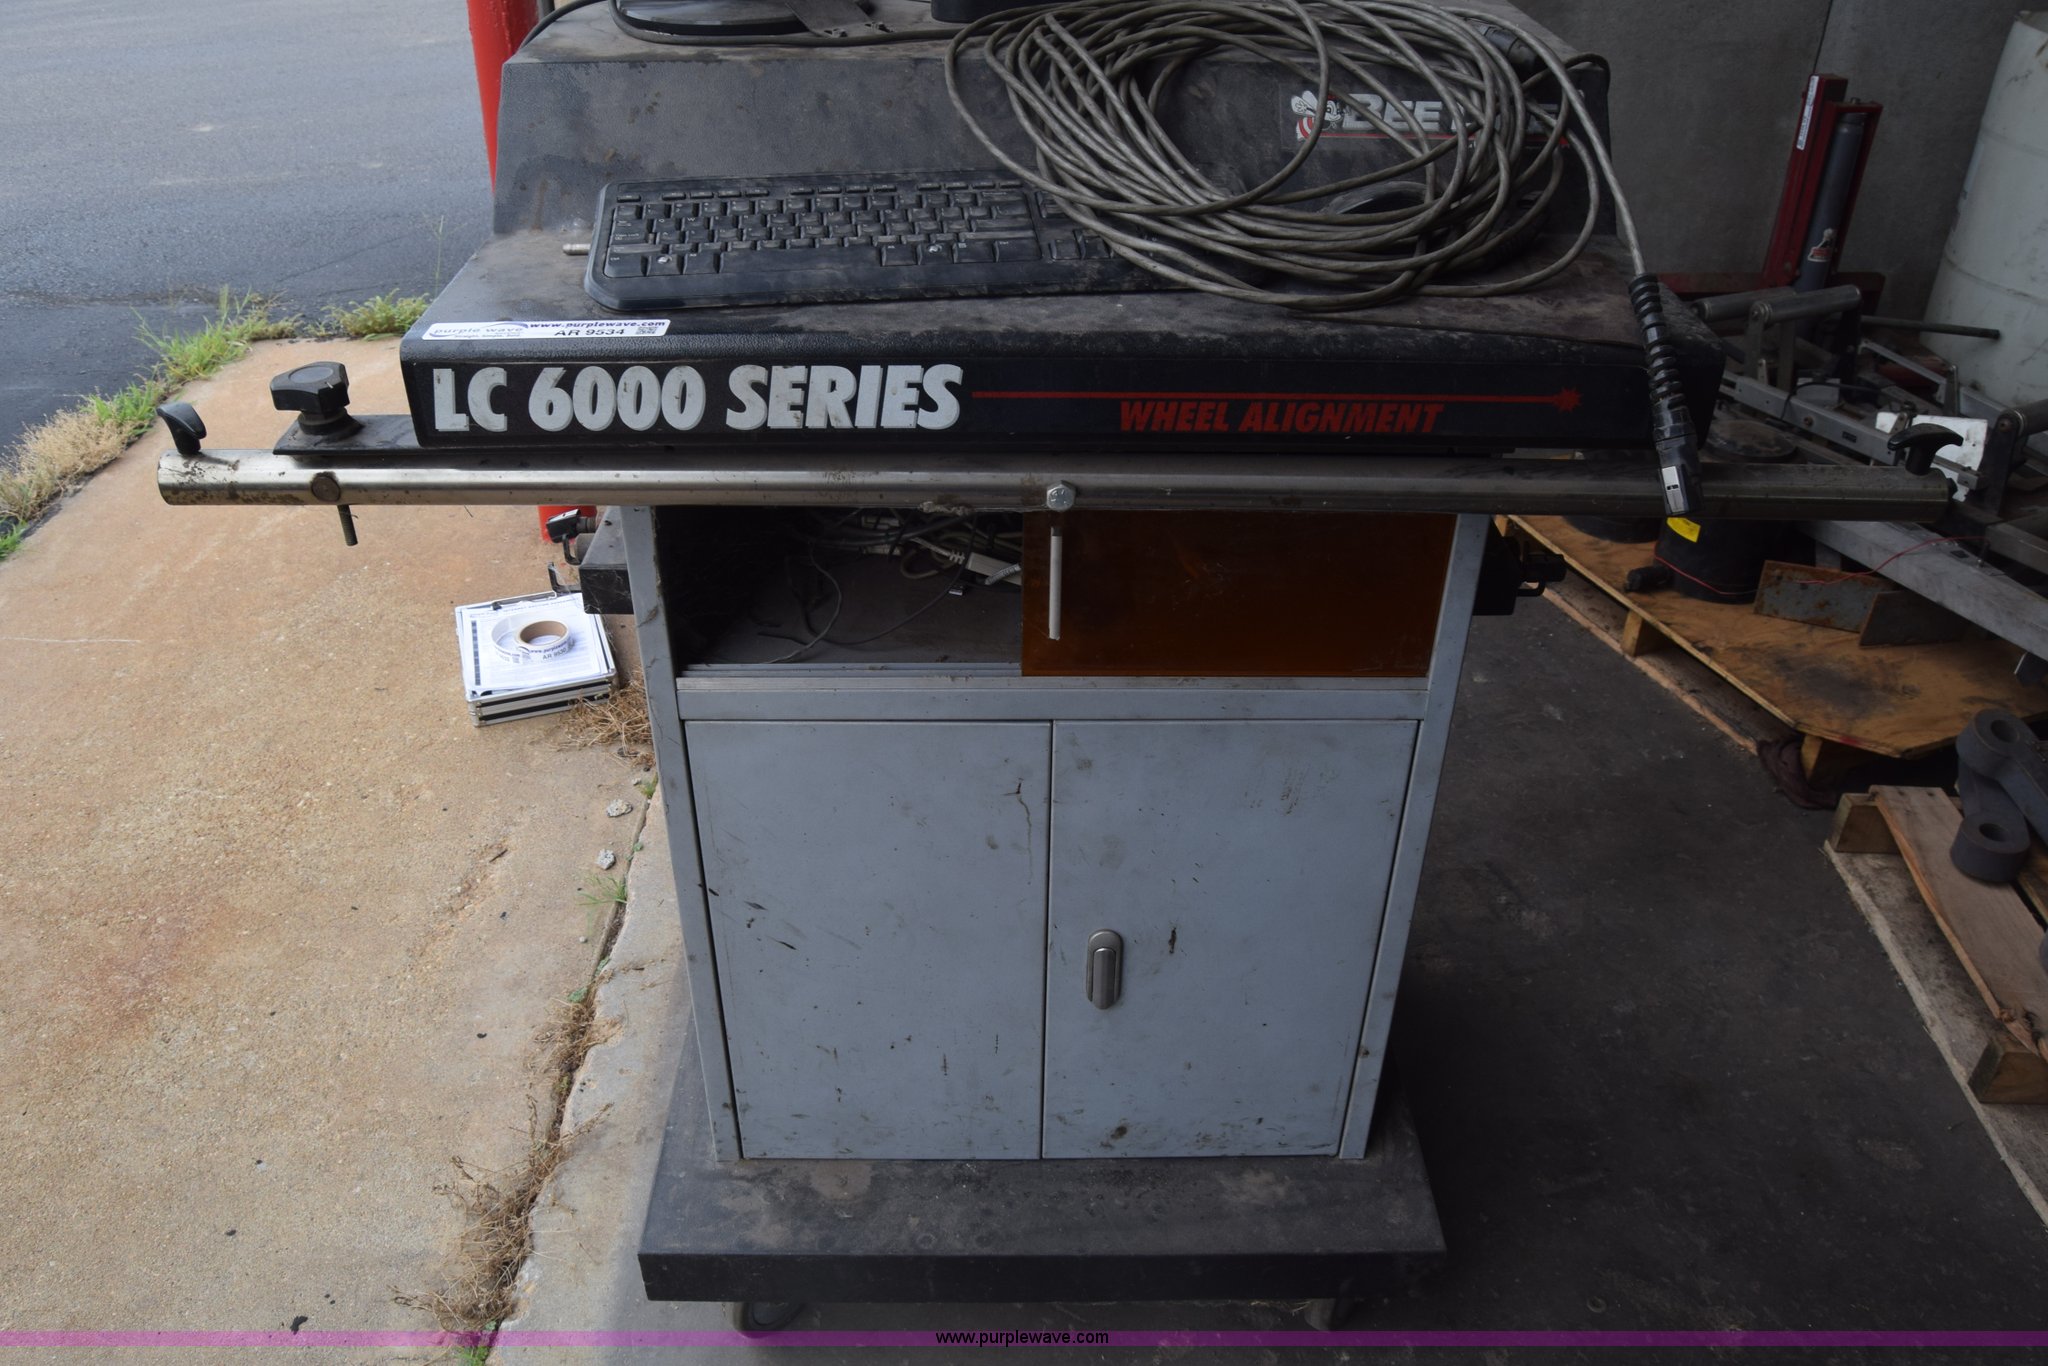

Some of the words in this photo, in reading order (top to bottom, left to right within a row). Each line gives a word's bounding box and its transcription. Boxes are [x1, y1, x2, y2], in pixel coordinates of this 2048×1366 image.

[1342, 93, 1443, 132] BEE
[434, 327, 480, 335] purple
[530, 320, 666, 329] www.purplewave.com
[433, 368, 508, 431] LC
[528, 365, 706, 432] 6000
[725, 363, 964, 430] SERIES
[1120, 401, 1230, 432] WHEEL
[1238, 403, 1444, 433] ALIGNMENT
